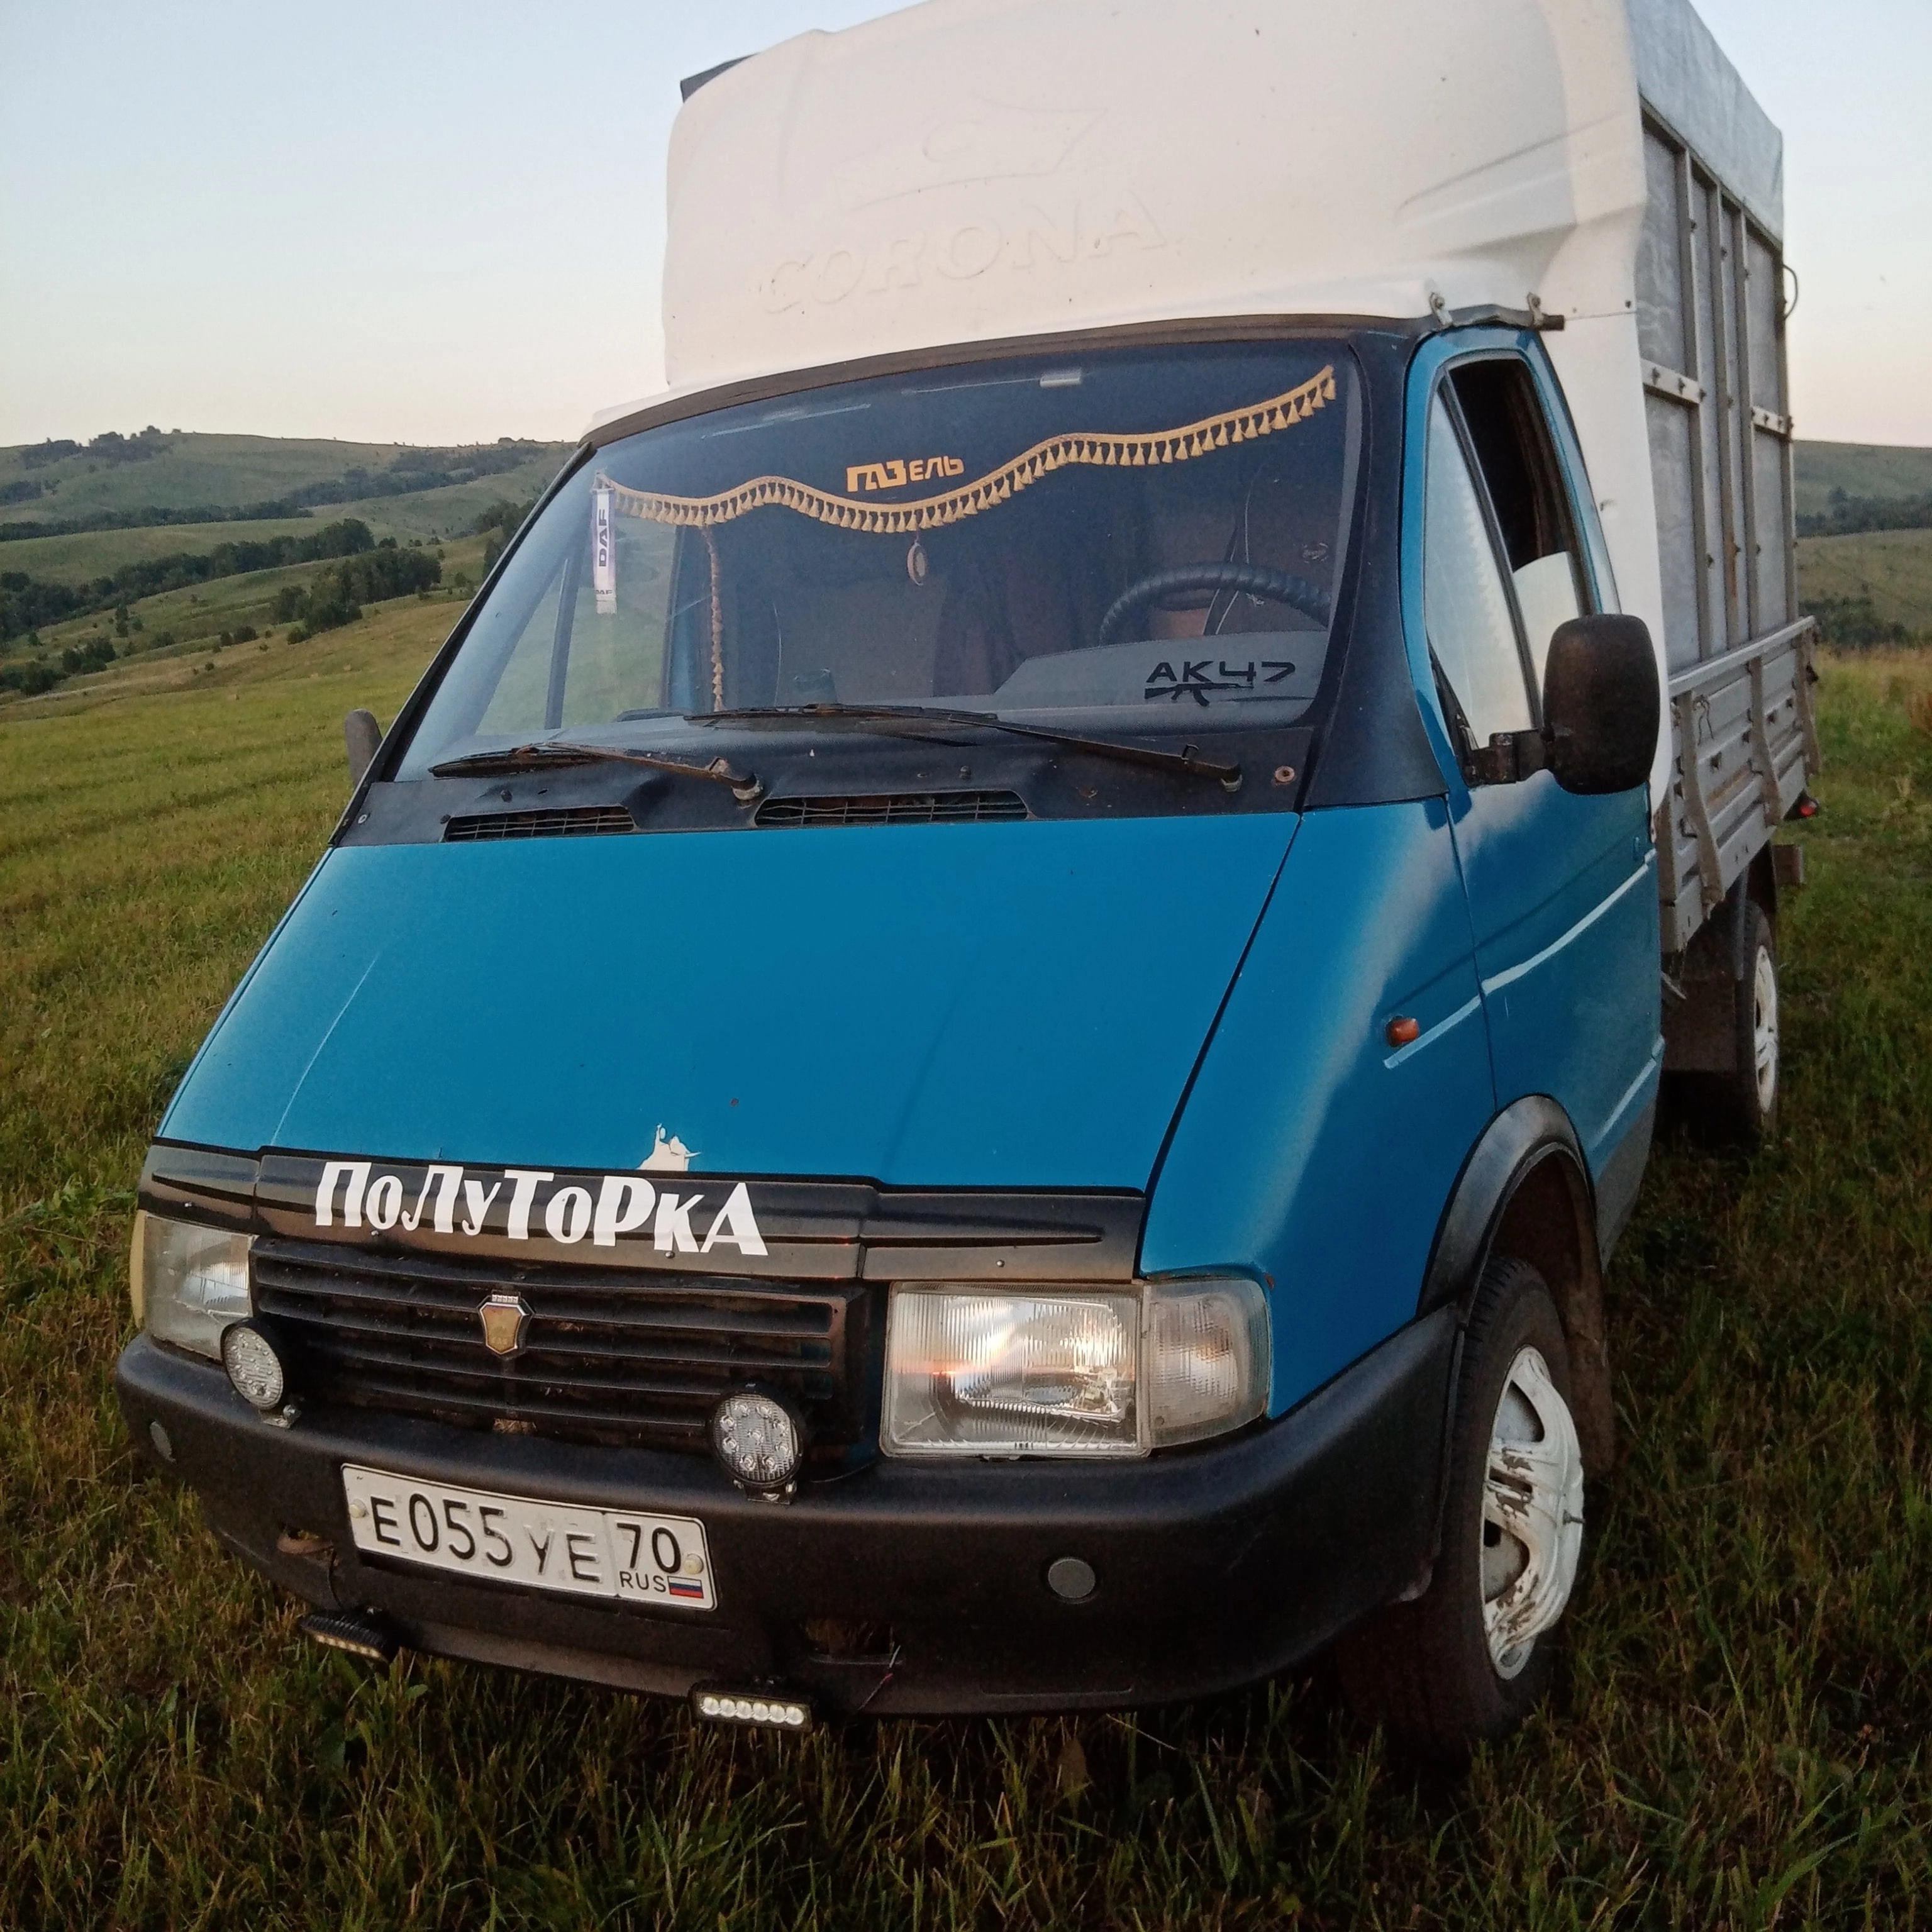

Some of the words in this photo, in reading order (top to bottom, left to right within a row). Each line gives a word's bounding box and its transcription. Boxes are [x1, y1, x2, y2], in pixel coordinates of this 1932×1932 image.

[758, 186, 1172, 315] CORONA
[598, 509, 608, 567] DAF
[1145, 660, 1296, 683] AK47
[619, 1570, 667, 1594] RUS
